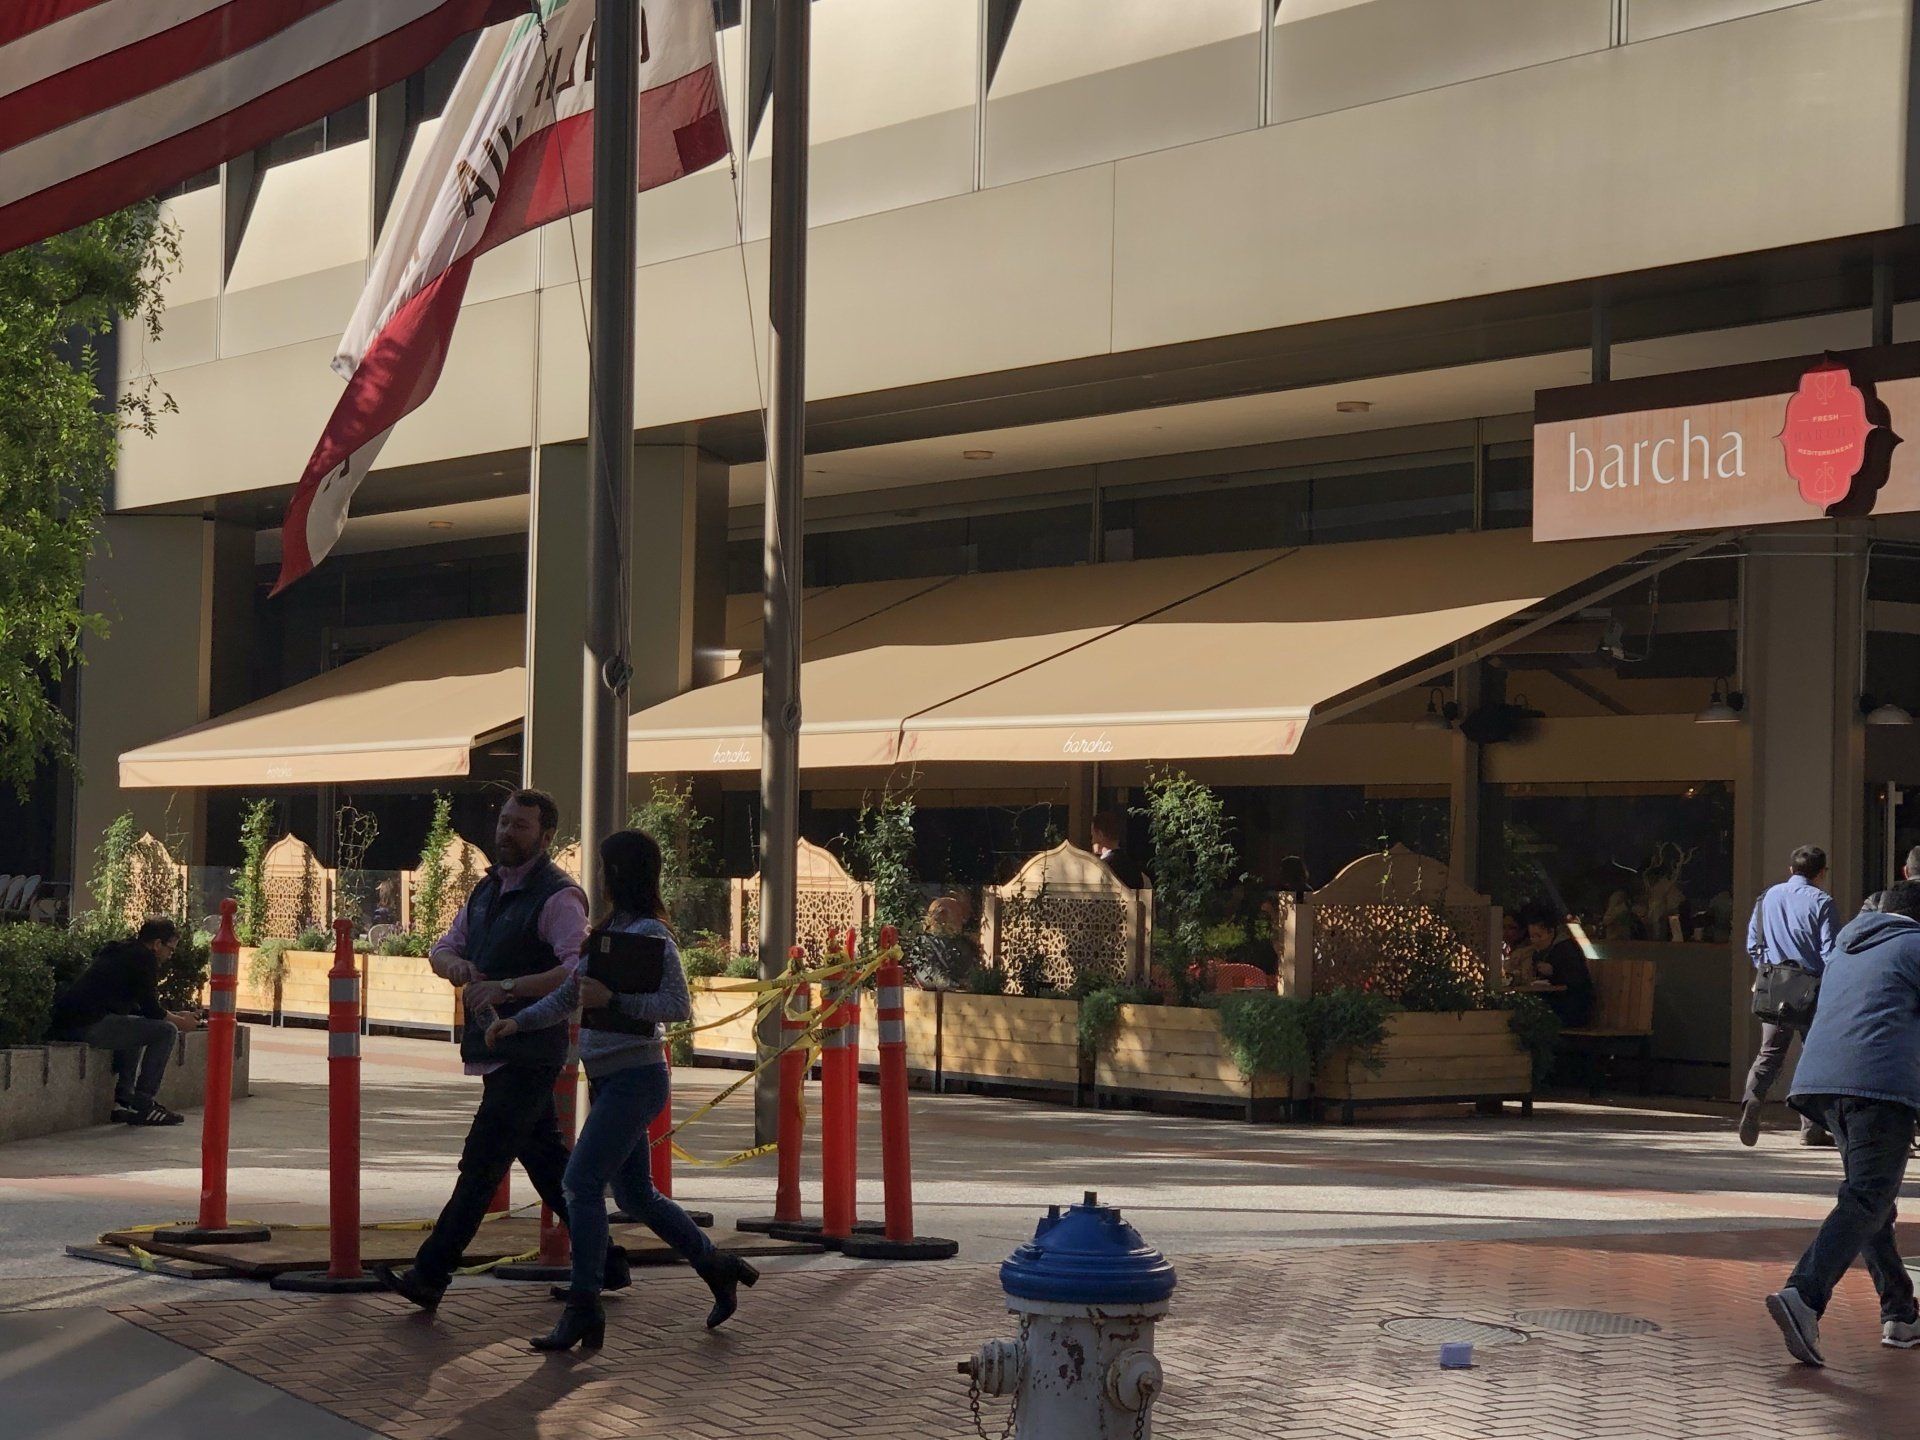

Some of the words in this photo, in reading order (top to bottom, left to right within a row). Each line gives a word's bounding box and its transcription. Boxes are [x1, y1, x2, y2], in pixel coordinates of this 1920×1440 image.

[1812, 414, 1838, 422] FRESH
[1569, 418, 1746, 493] barcha
[1062, 730, 1114, 753] barcha
[712, 742, 752, 764] barcha
